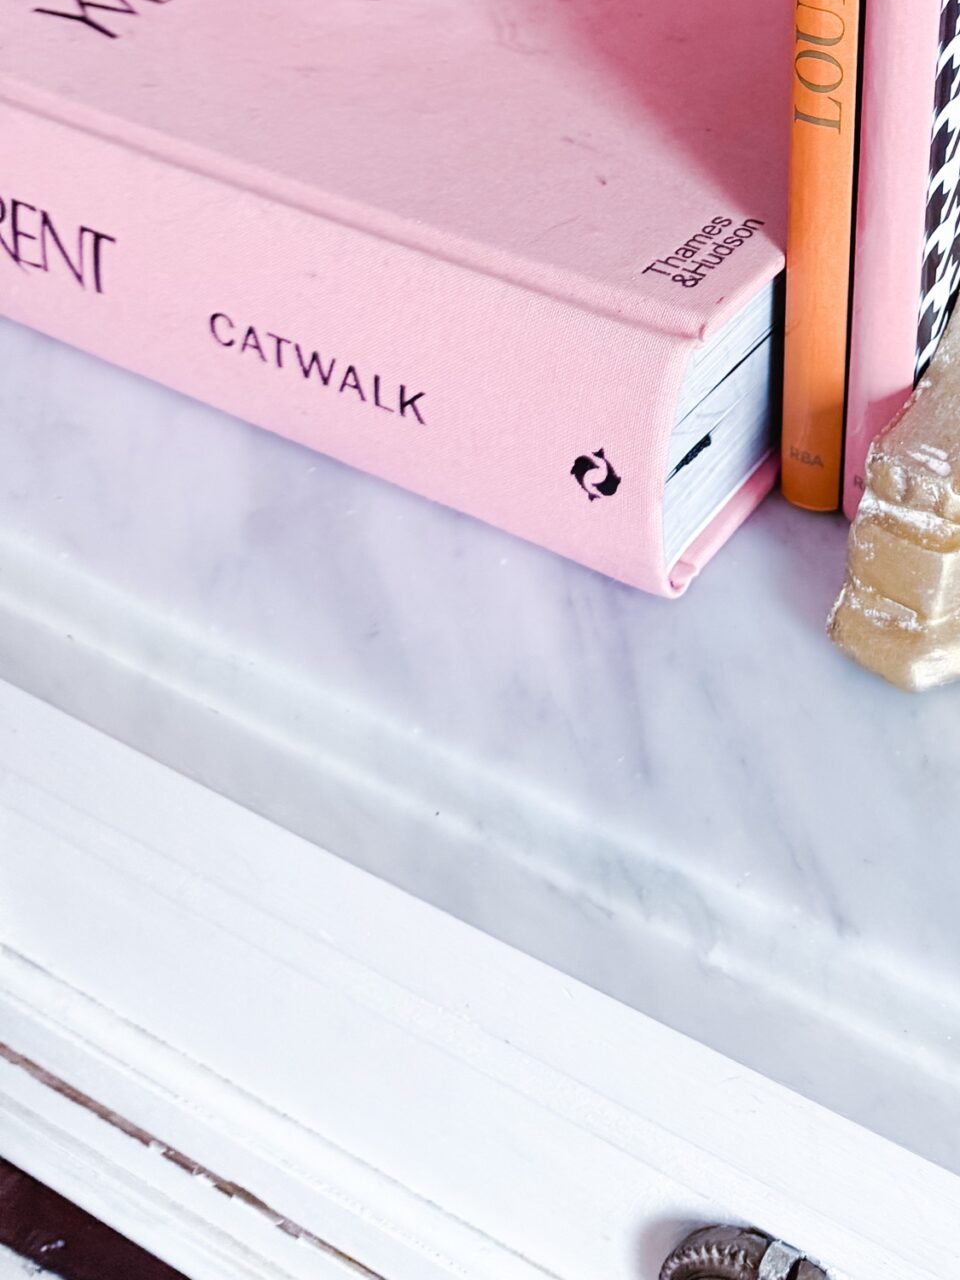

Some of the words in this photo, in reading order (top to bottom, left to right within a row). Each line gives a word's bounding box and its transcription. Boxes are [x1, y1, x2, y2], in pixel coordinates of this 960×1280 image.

[641, 215, 733, 277] Thames
[671, 218, 766, 288] &Hudson
[208, 311, 427, 426] CATWALK
